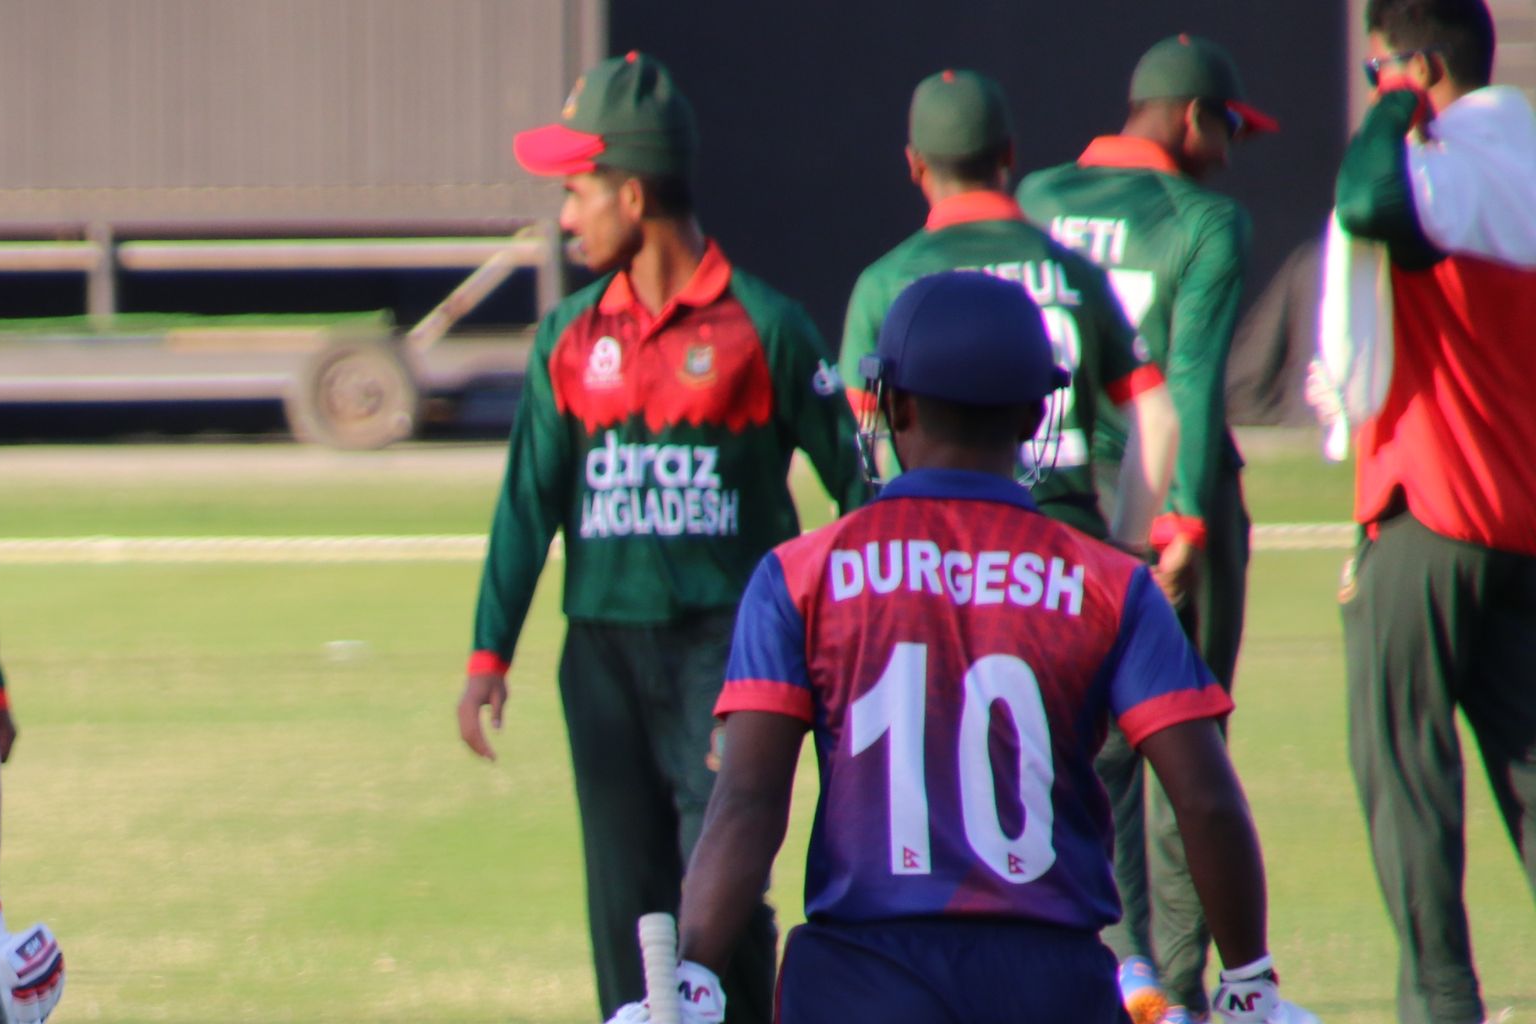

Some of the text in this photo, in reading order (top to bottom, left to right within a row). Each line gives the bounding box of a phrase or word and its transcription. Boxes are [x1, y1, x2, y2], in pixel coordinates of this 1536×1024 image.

[585, 429, 721, 490] daraz
[830, 538, 1084, 617] DURGESH
[850, 641, 1057, 884] 10
